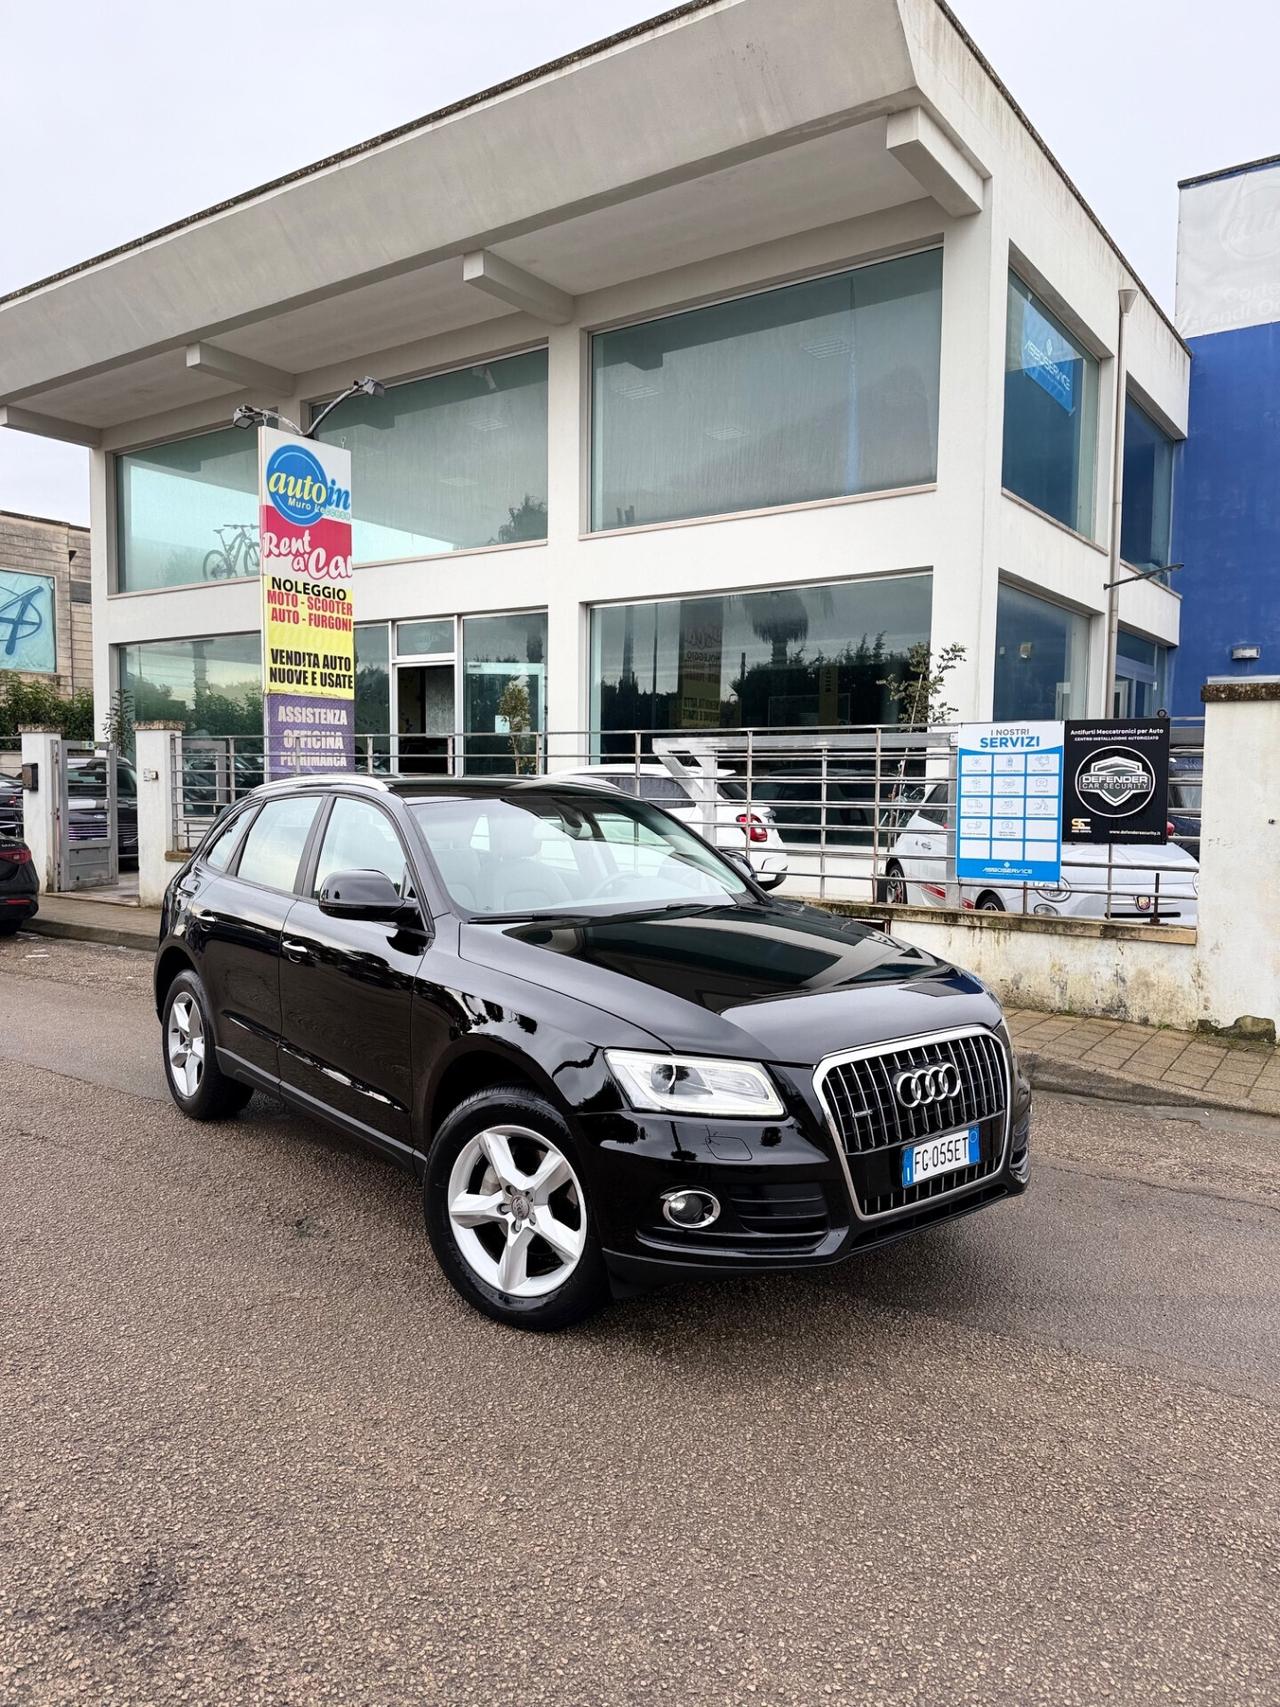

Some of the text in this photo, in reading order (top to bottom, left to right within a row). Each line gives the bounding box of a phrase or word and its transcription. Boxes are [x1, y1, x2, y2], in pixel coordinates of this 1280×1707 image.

[288, 497, 311, 511] Muro
[263, 530, 312, 556] Rent
[271, 576, 347, 601] NOLEGGIO
[267, 589, 298, 608] MOTO
[307, 596, 352, 616] SCOOTER
[271, 608, 300, 625] AUTO
[308, 613, 352, 632] FURGONI
[271, 648, 351, 672] VENDITA AUTO
[269, 667, 353, 689] NUOVE E USATE
[278, 705, 348, 725] ASSISTENZA
[283, 729, 345, 750] OFFICINA
[980, 736, 1040, 748] SERVIZI
[996, 728, 1030, 736] NOSTRI
[1082, 775, 1148, 783] DEFENDER
